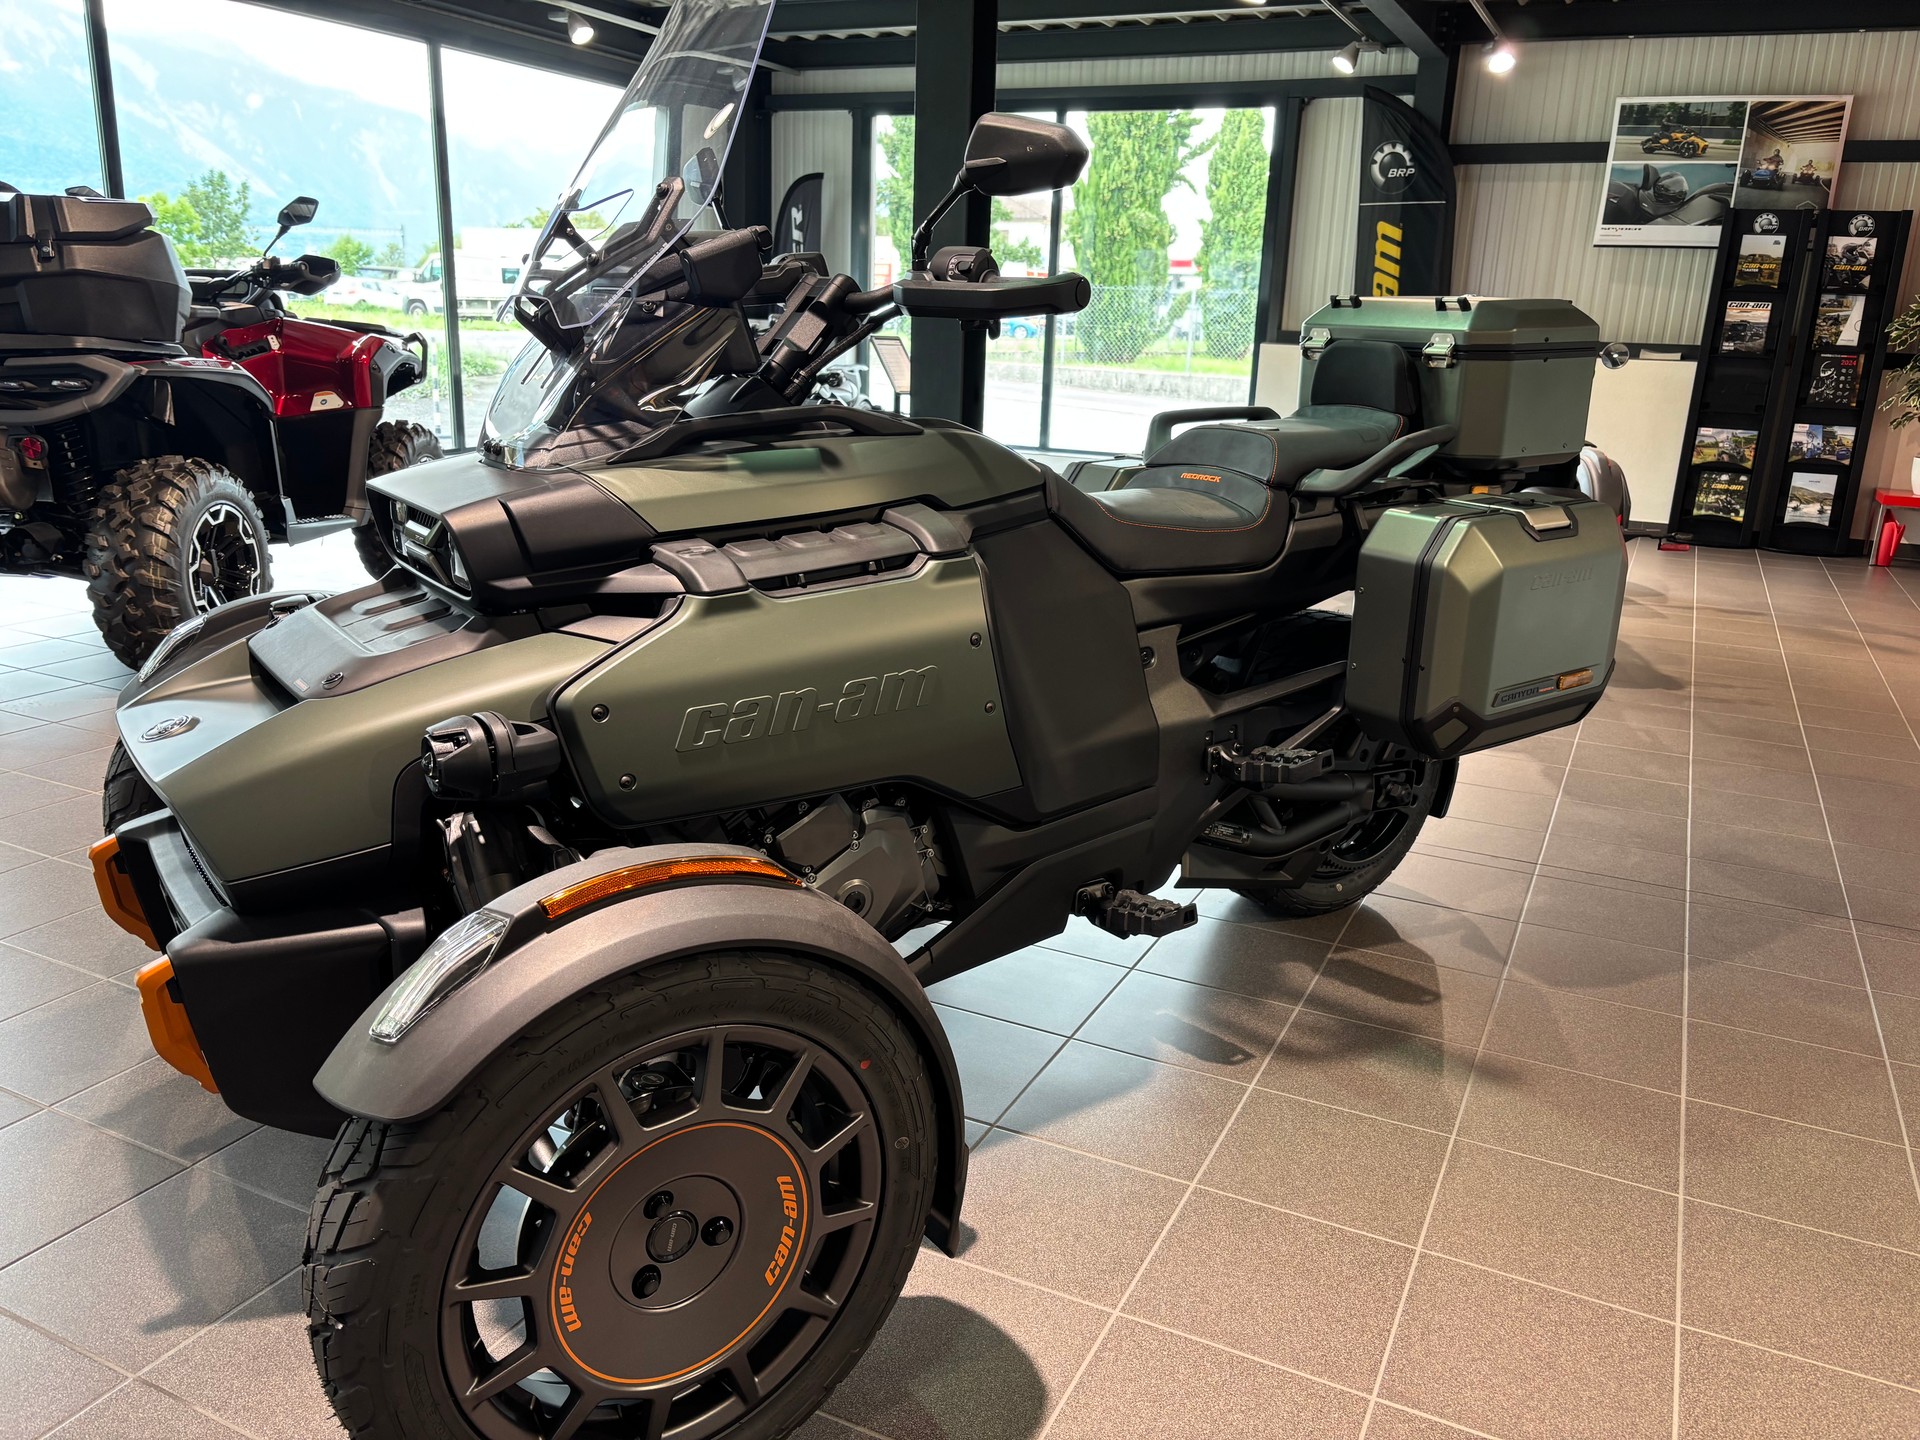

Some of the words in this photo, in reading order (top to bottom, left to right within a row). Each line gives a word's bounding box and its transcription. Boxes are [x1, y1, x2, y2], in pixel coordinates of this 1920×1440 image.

[1388, 168, 1416, 178] BRP
[1180, 472, 1221, 482] REDROCK
[1711, 483, 1745, 491] can-am
[1530, 568, 1593, 590] can-am
[1501, 687, 1540, 702] CANYON
[675, 665, 938, 752] can-am
[666, 1222, 678, 1252] can-am
[764, 1175, 798, 1287] can-am
[558, 1211, 593, 1333] can-am
